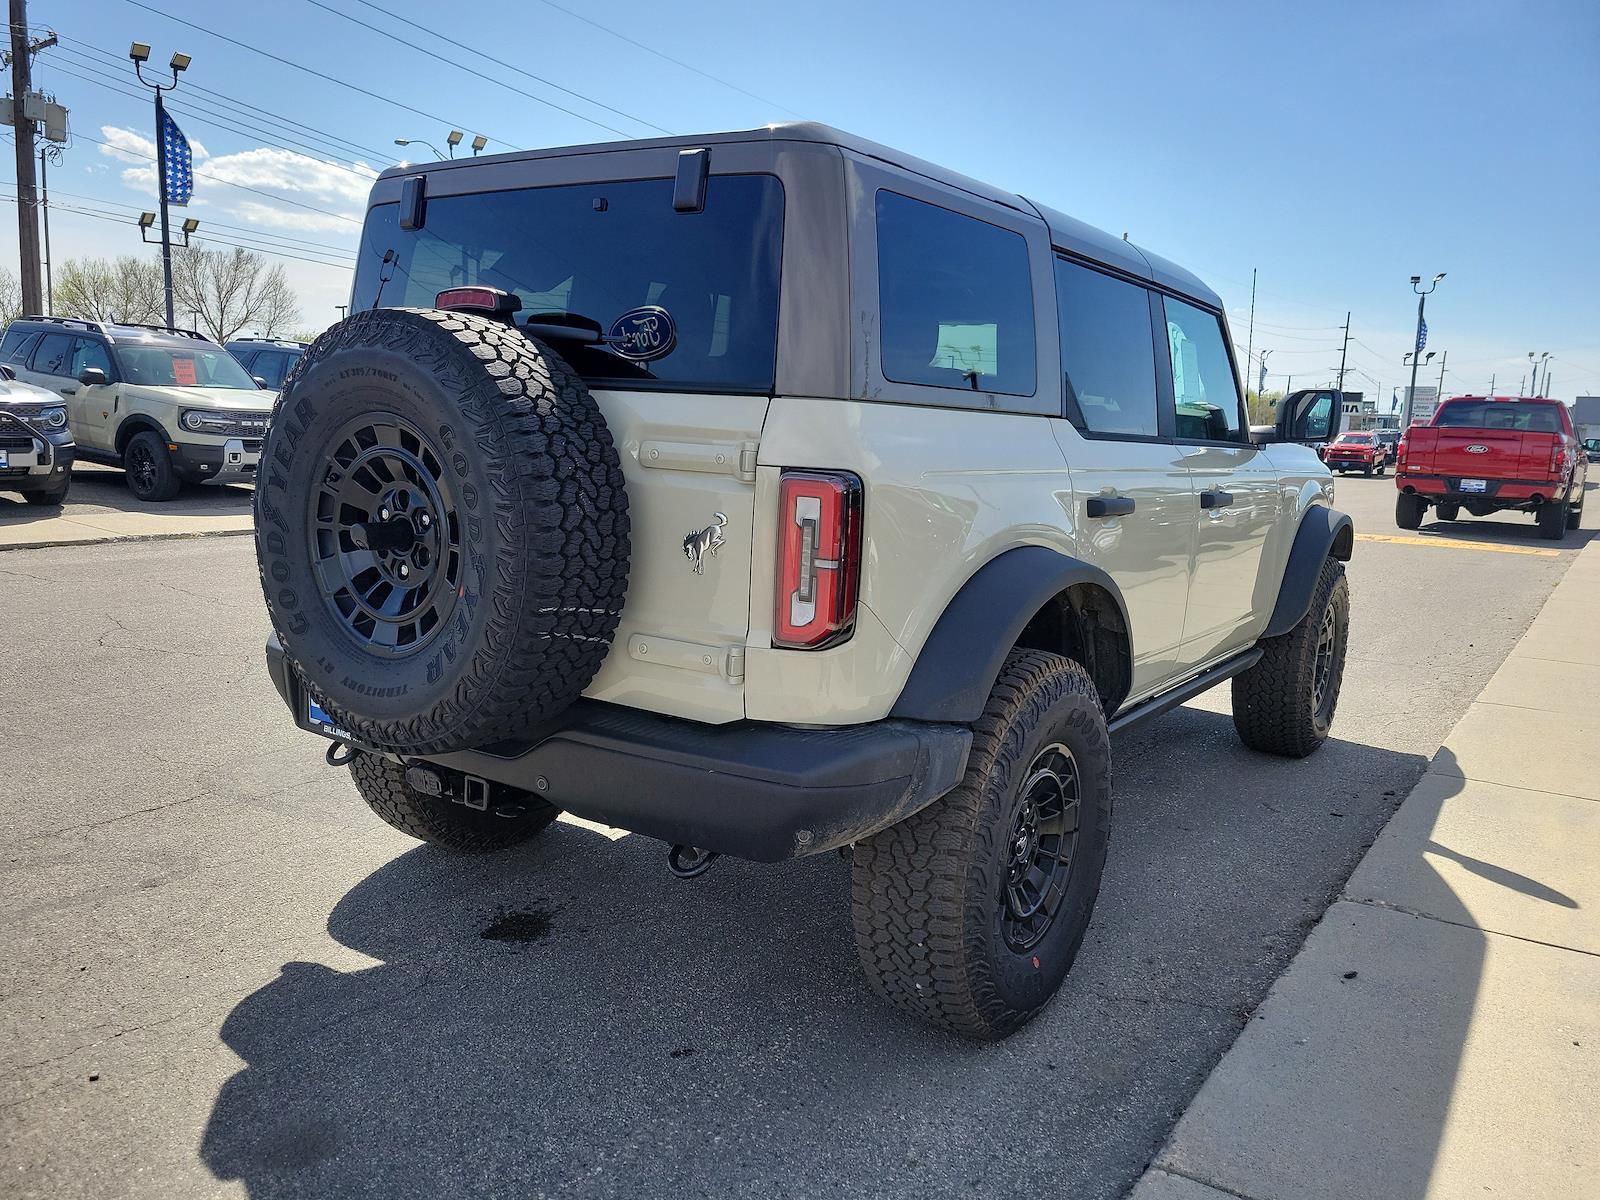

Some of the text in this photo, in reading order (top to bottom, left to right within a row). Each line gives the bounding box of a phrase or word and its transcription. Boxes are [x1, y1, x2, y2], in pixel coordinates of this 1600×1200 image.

[262, 396, 318, 636] GOODYEAR
[425, 424, 484, 683] GOODYEAR
[341, 676, 409, 698] TERRITORY
